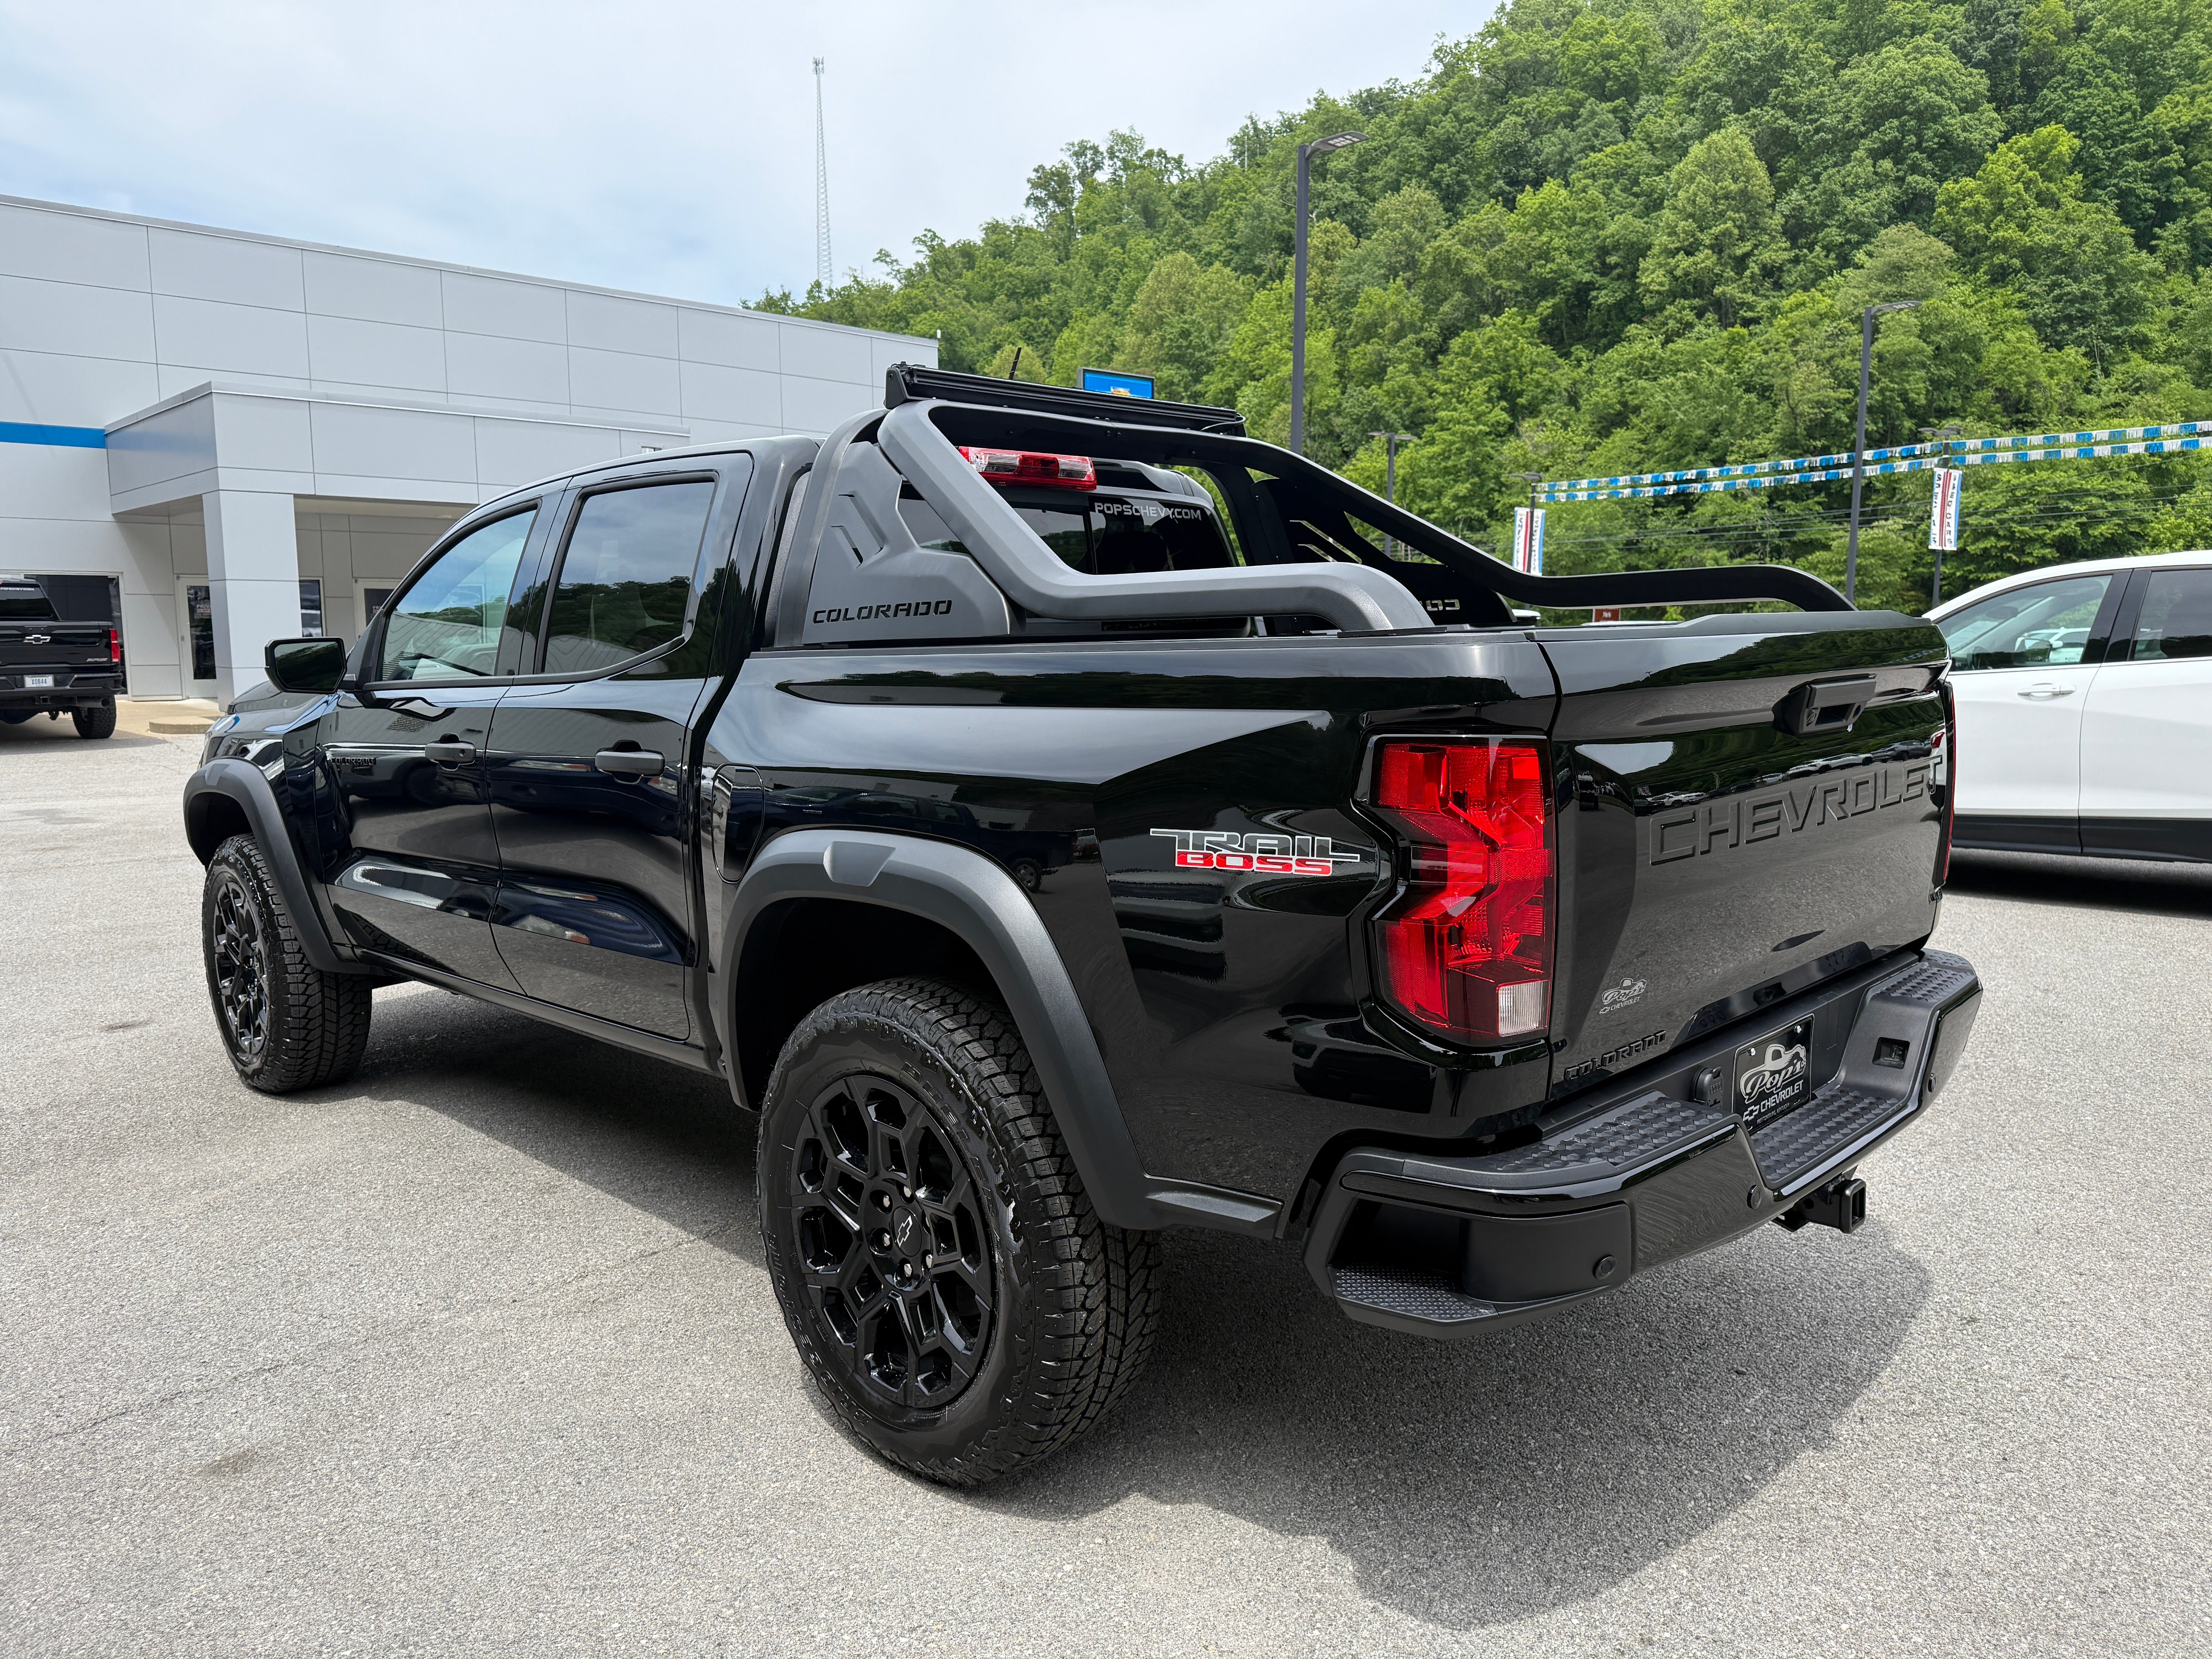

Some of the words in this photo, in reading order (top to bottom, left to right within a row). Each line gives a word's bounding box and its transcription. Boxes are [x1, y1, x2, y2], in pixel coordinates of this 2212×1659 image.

[1095, 501, 1202, 521] POPSCHEVY.COM
[812, 599, 952, 624] COLORADO
[1649, 754, 1943, 866] CHEVROLET
[1149, 828, 1360, 863] TRAIL
[1175, 850, 1333, 876] BOSS
[1611, 996, 1641, 1010] CHEVROLET
[1563, 1030, 1666, 1080] COLORADO
[1745, 1059, 1803, 1098] Pop's
[1760, 1079, 1803, 1113] CHEVROLET
[767, 1230, 872, 1426] BRIDGESTONE
